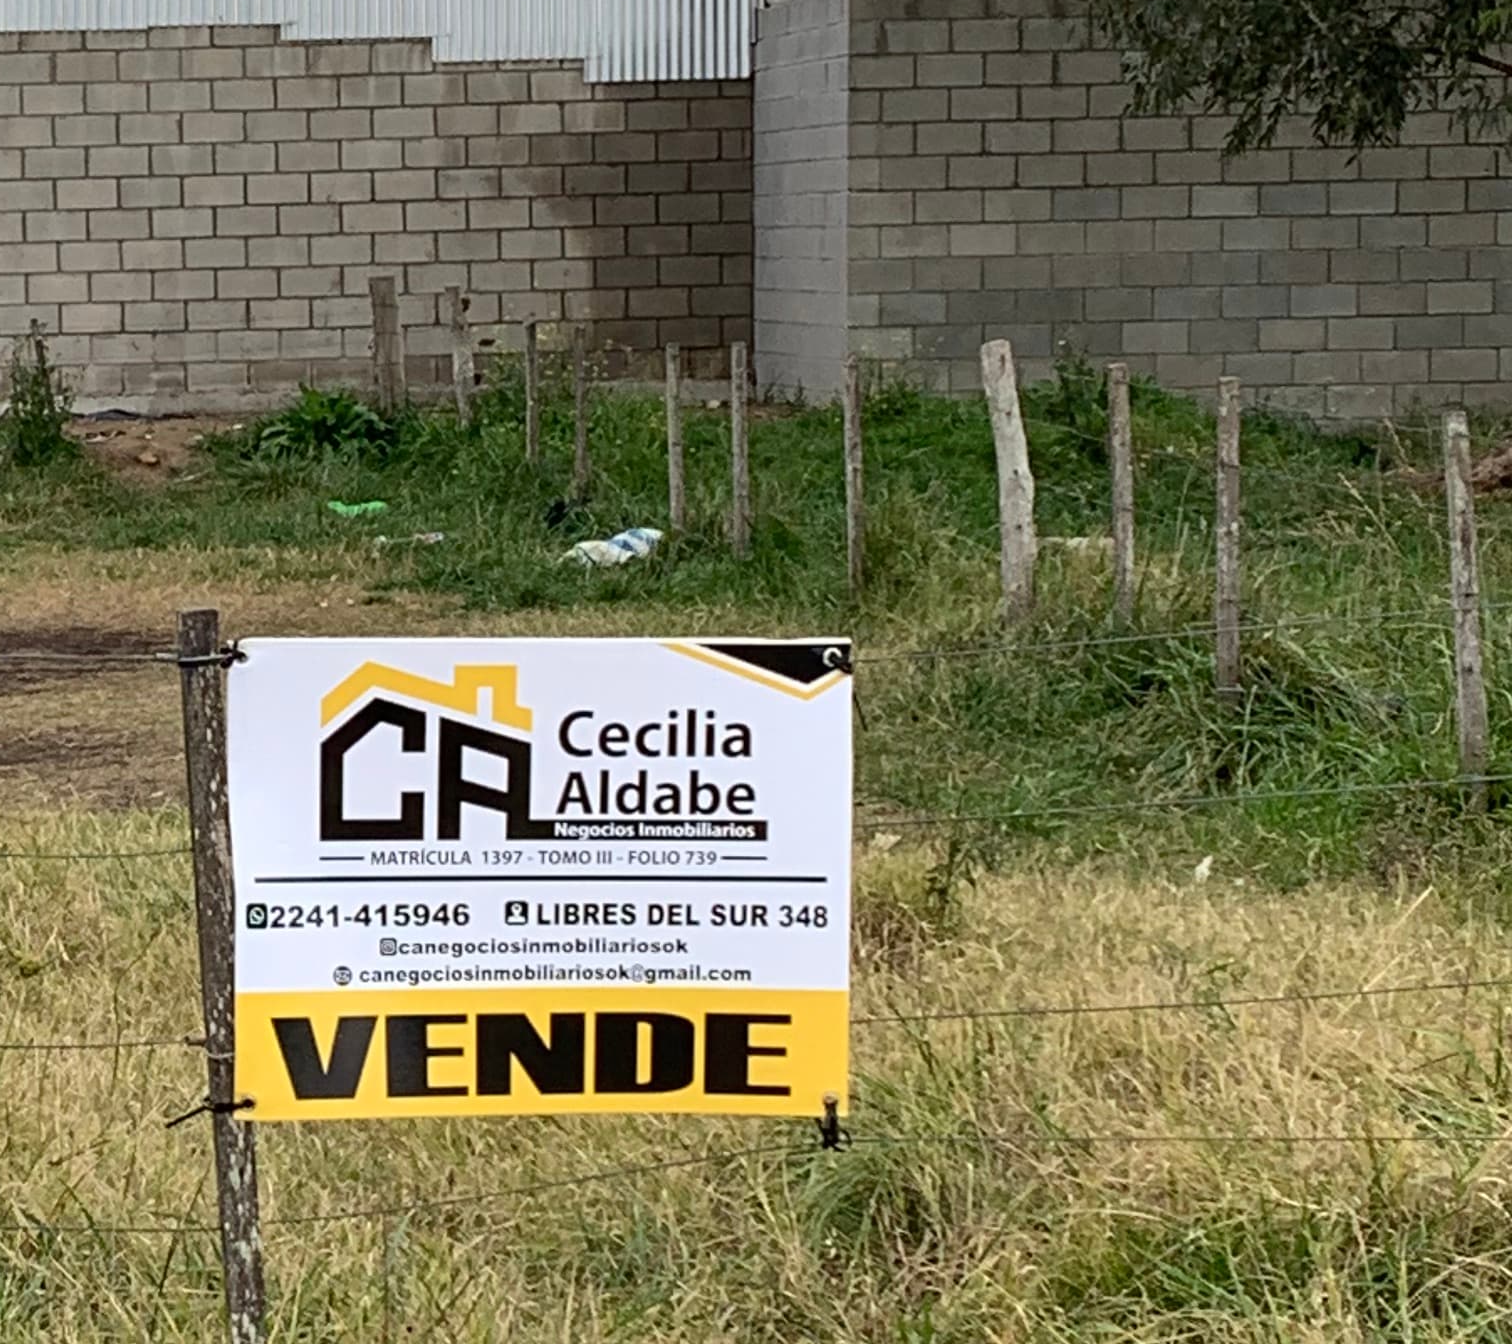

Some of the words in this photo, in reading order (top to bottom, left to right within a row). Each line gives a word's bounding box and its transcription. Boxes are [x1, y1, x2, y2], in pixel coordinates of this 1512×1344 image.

[558, 709, 752, 757] Cecilia
[555, 770, 756, 815] Aldabe
[554, 821, 635, 840] Negocios
[639, 821, 755, 838] Inmobiliarios
[370, 847, 472, 865] MATRÍCULA
[482, 850, 522, 865] 1397
[538, 850, 591, 865] TOMO
[597, 850, 612, 865] III
[628, 850, 680, 865] FOLIO
[685, 850, 717, 865] 739
[270, 903, 471, 928] 2241-415946
[537, 903, 637, 926] LIBRES
[648, 903, 700, 926] DEL
[710, 904, 768, 927] SUR
[779, 905, 828, 928] 348
[398, 937, 689, 957] canegociosinmobiliariosok
[359, 964, 752, 986] canegociosinmobiliariosok@gmail.com
[271, 1012, 792, 1100] VENDE
